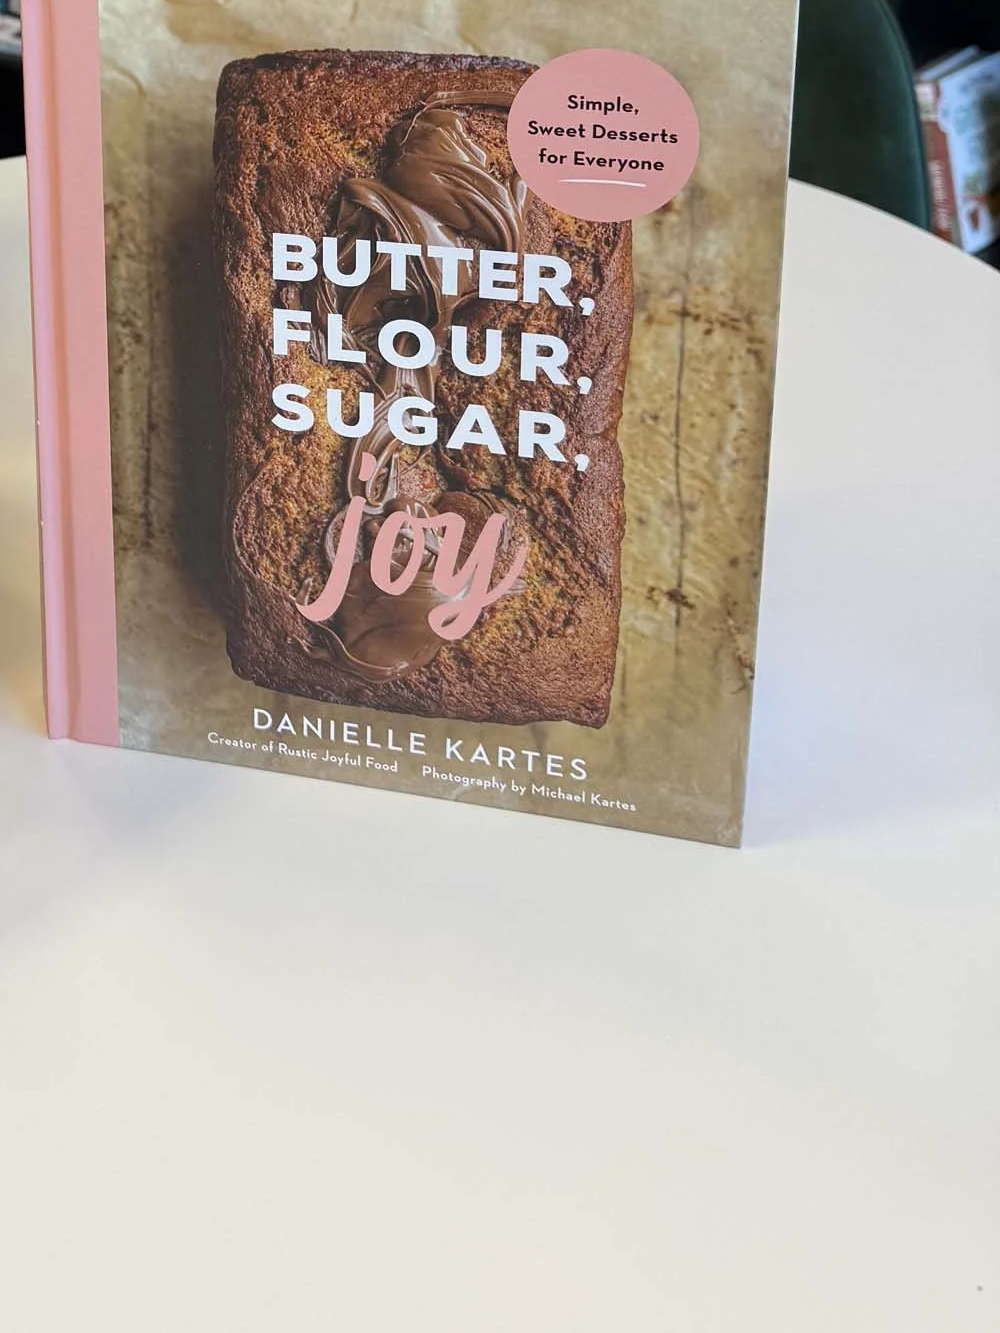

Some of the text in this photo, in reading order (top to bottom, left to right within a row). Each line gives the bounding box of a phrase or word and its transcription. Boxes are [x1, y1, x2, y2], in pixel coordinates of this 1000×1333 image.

[527, 120, 678, 144] Sweet Desserts
[567, 94, 640, 116] Simple,
[538, 148, 665, 173] for Everyone
[272, 232, 596, 317] BUTTER,
[272, 308, 593, 395] FLOUR,
[271, 383, 591, 473] SUGAR,
[295, 451, 528, 641] joy
[207, 732, 398, 773] Creator of Rustic Joyful Food
[253, 708, 588, 781] DANIELLE KARTES
[422, 765, 637, 812] Photography by Michael Kartes
